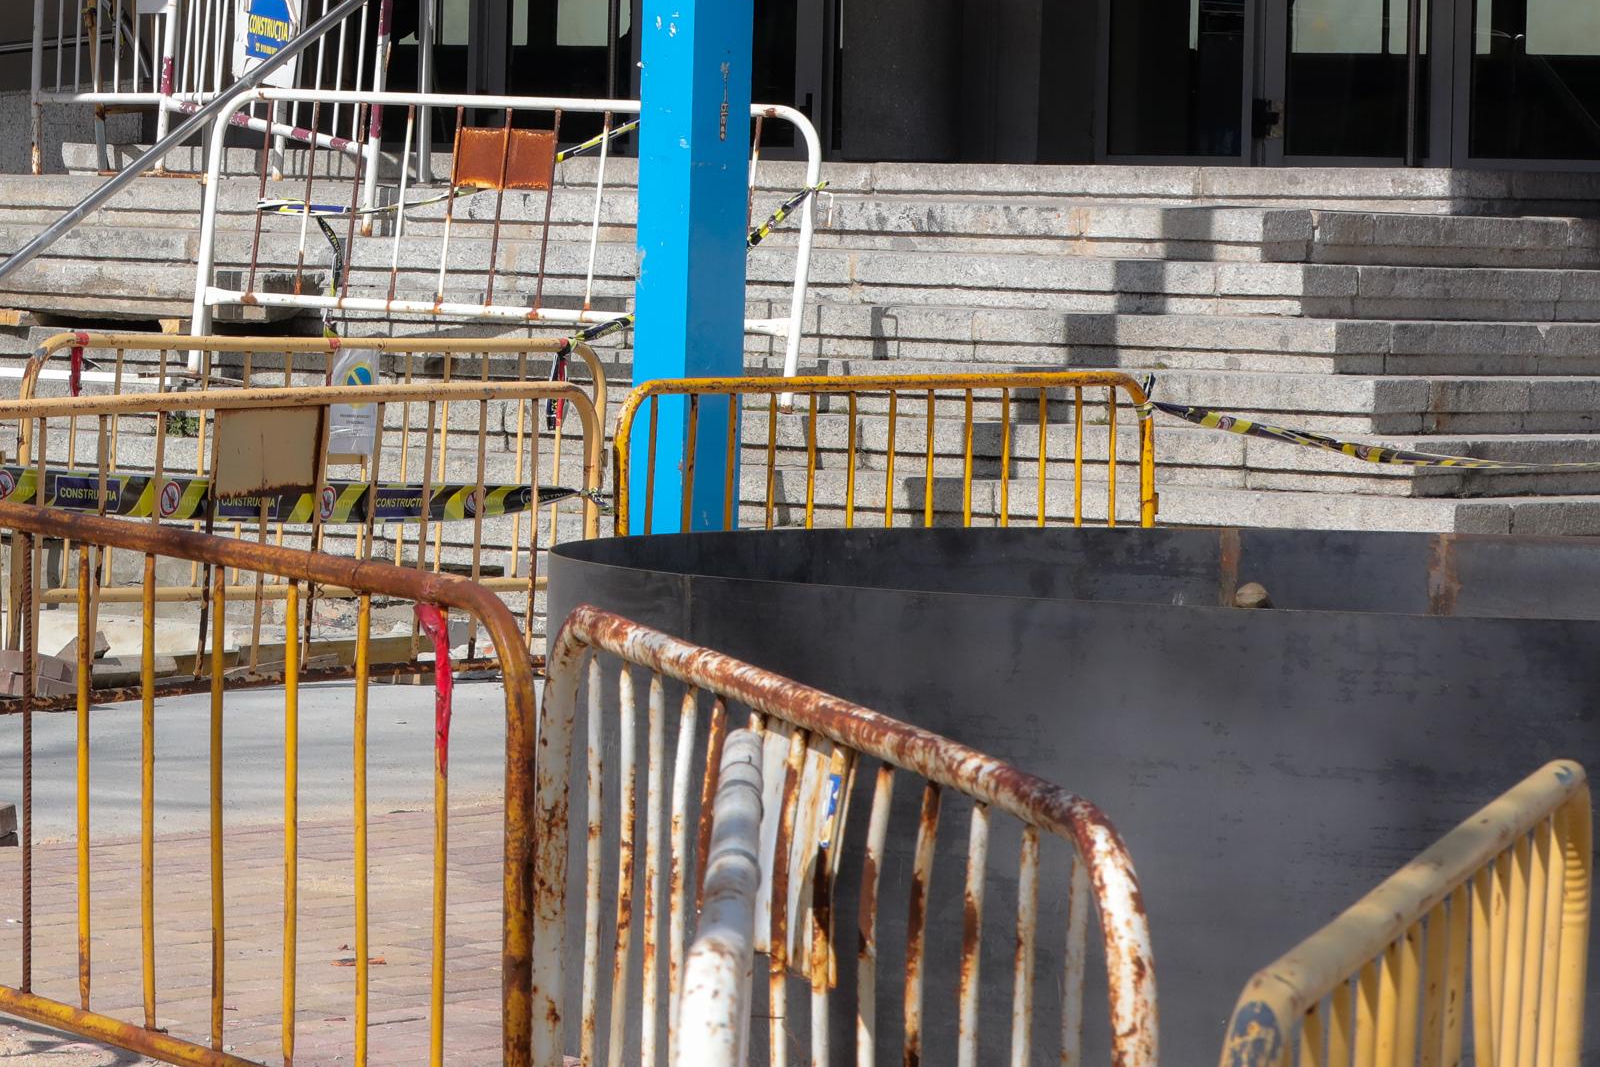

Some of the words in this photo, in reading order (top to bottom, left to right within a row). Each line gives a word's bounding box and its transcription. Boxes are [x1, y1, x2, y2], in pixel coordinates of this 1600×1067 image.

[248, 15, 289, 42] CONSTRUCTIA
[59, 486, 118, 502] CONSTRUTIA
[375, 497, 424, 509] CONSTRUCTI
